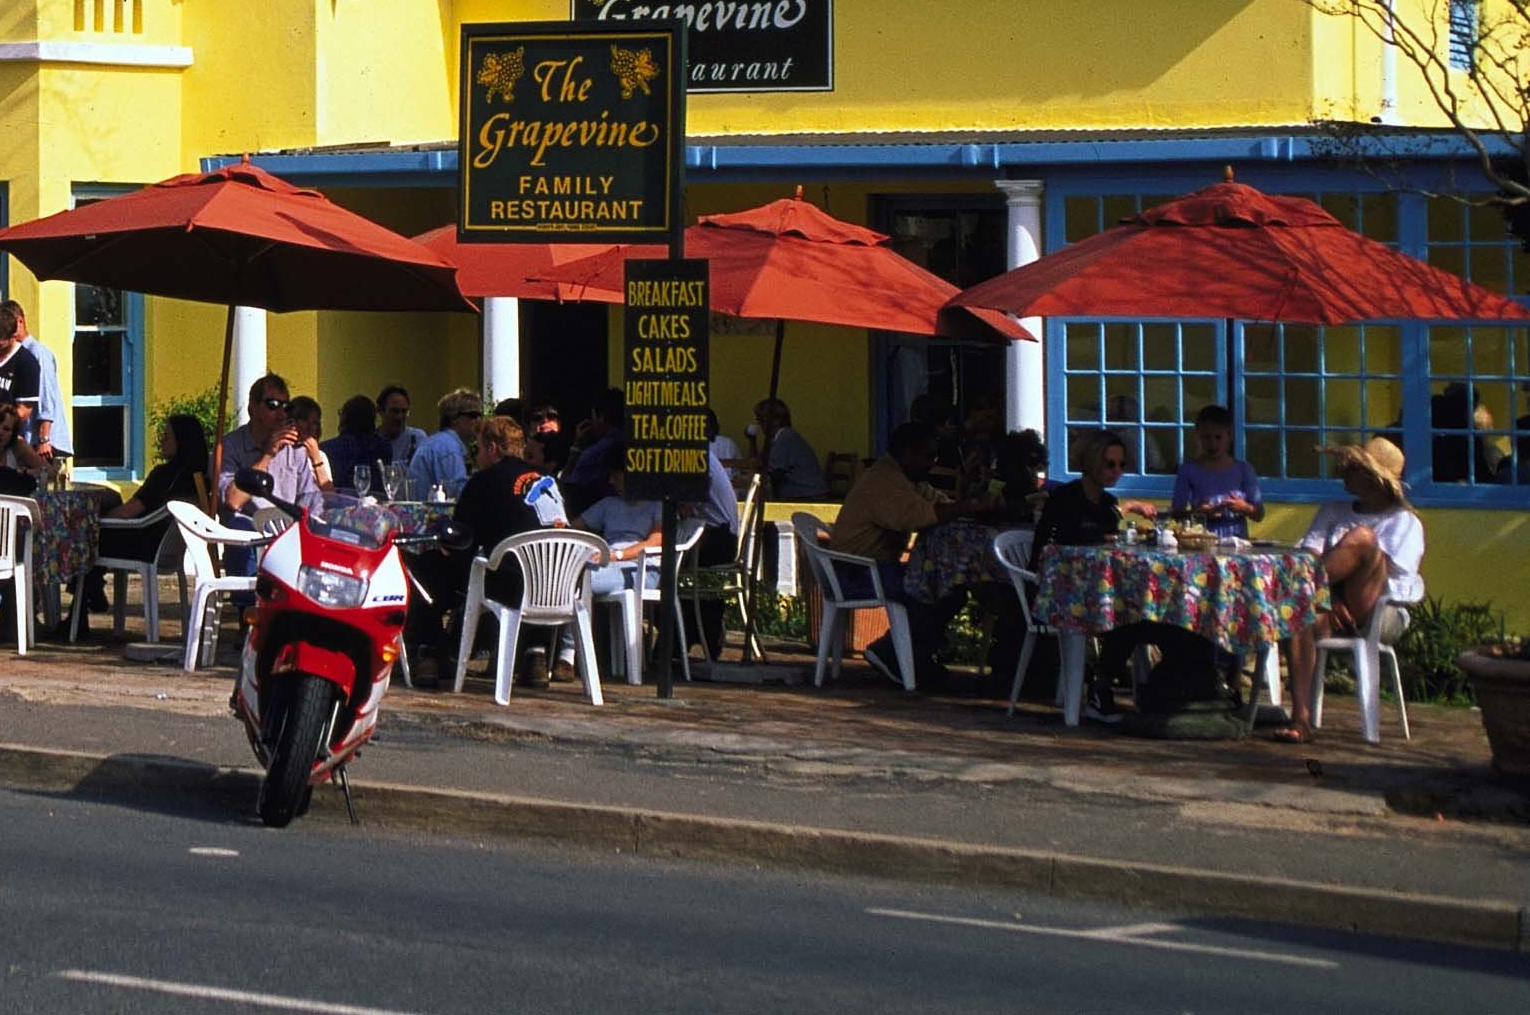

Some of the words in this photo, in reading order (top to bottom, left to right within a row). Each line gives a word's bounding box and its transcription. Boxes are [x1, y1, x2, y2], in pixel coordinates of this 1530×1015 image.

[533, 56, 593, 103] The
[686, 57, 794, 82] aurant
[473, 110, 660, 169] Grapevine
[520, 176, 614, 195] FAMILY
[491, 200, 644, 220] RESTAURANT
[628, 280, 705, 307] BREAKFAST
[638, 314, 690, 339] CAKES
[632, 346, 697, 373] SALADS
[626, 380, 659, 406] LIGHT
[660, 380, 707, 406] MEALS
[631, 414, 659, 440] TEA
[665, 414, 708, 441] COFFEE
[626, 448, 662, 473] SOFT
[663, 448, 708, 474] DRINKS
